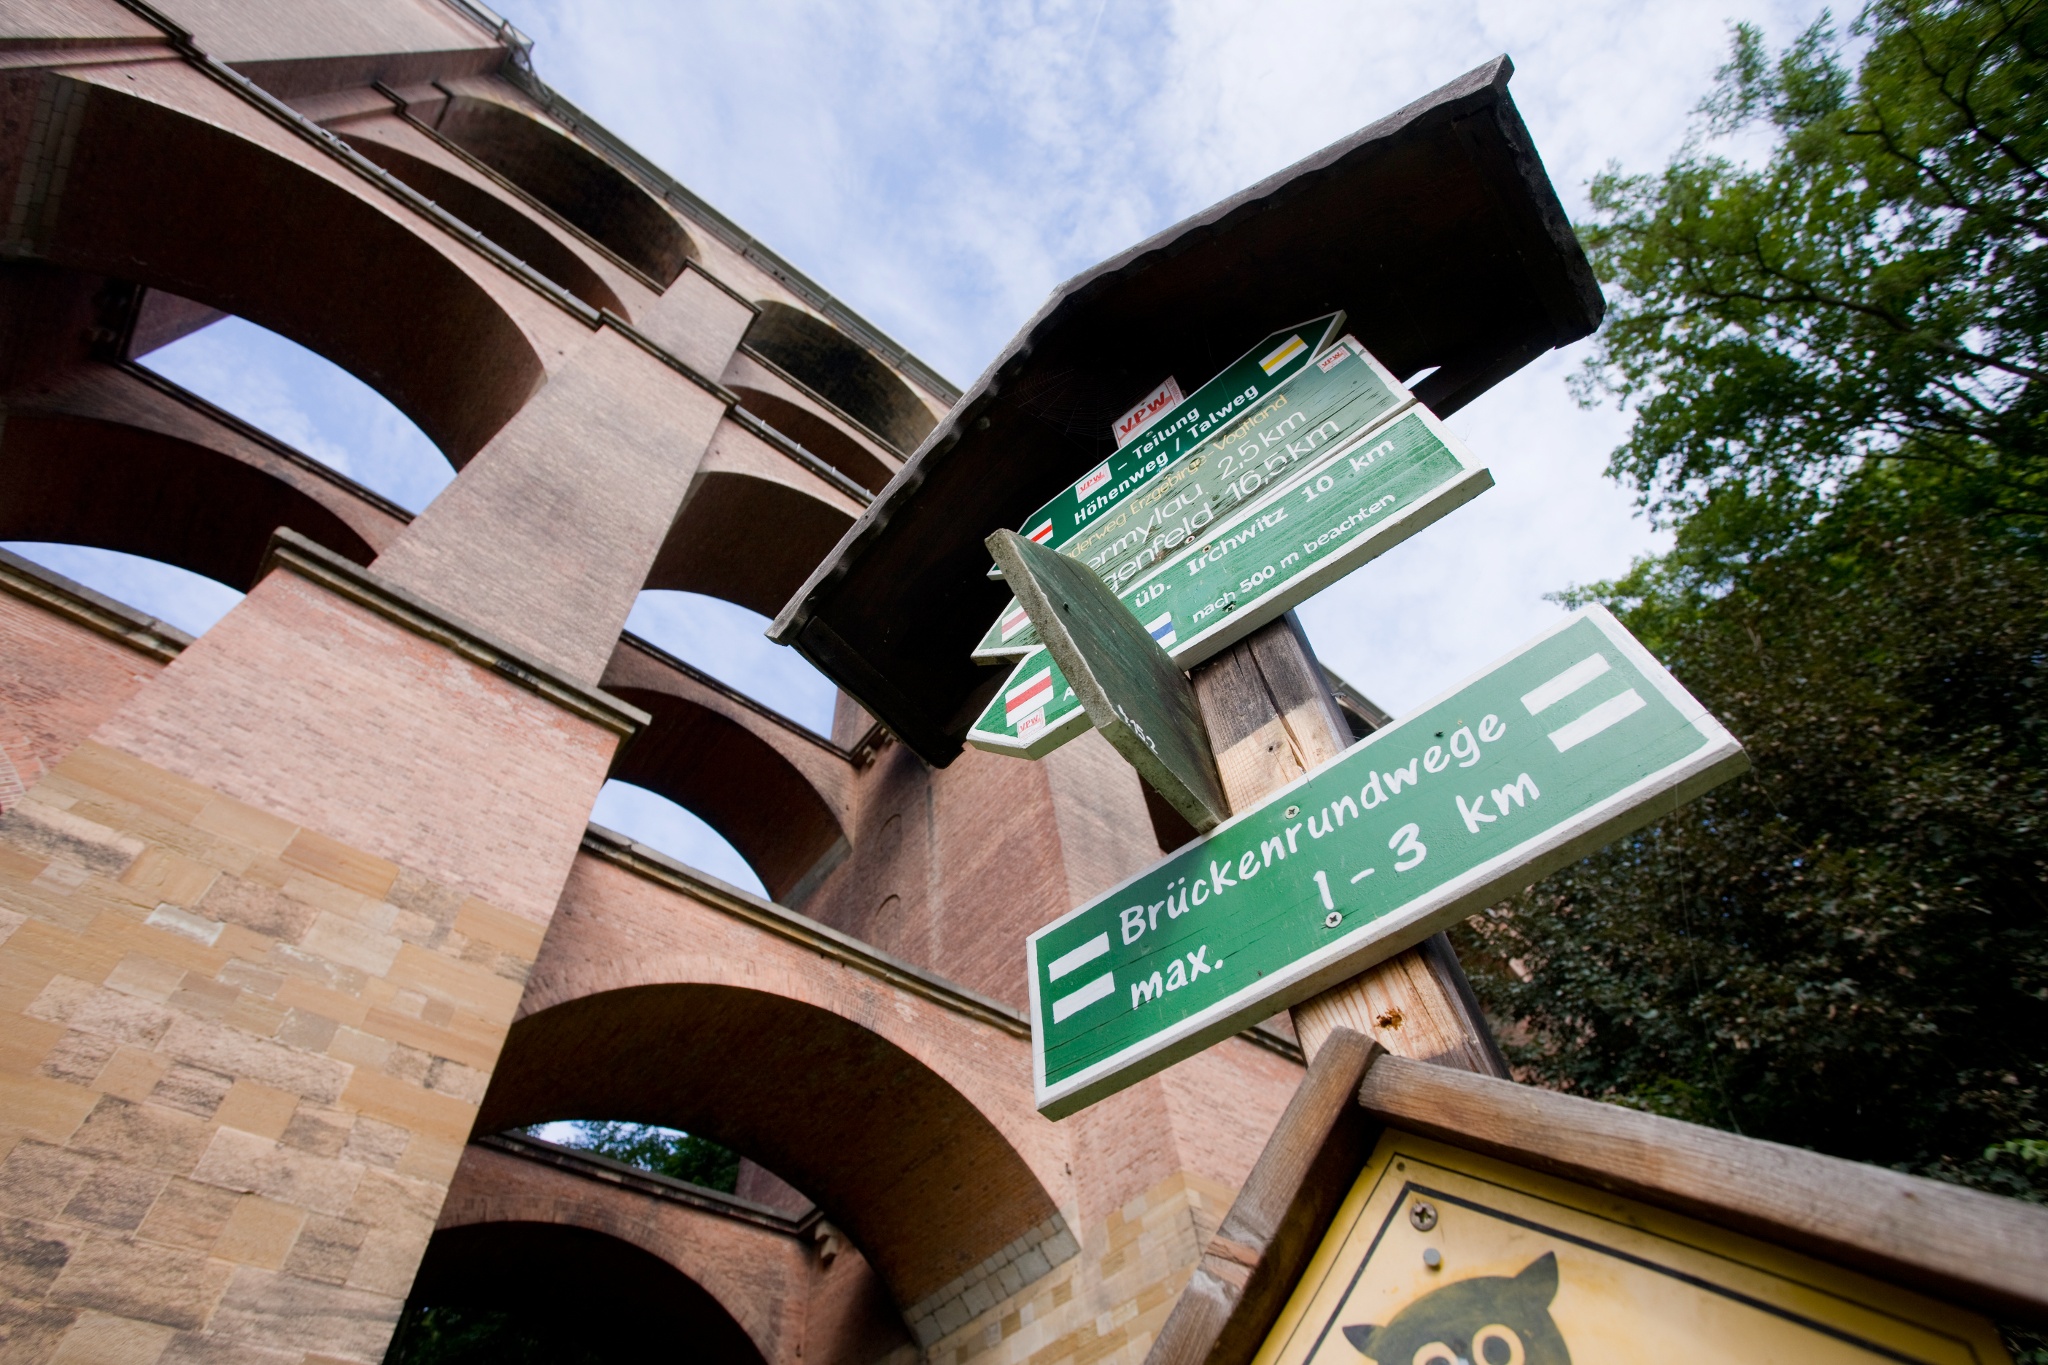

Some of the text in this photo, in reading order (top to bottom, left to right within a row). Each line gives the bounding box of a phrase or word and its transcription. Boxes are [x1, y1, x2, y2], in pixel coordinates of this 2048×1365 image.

[1074, 451, 1169, 526] Höhenweg
[1187, 385, 1259, 439] Talweg
[1120, 391, 1165, 434] VPW
[1132, 407, 1200, 460] Teilung
[1087, 483, 1204, 571] ermylau
[1103, 502, 1214, 594] genfeld
[1285, 420, 1340, 461] km
[1134, 439, 1395, 608] üb. Irchwitz 10 km
[1192, 494, 1396, 624] nach 500 m beachten
[1119, 713, 1507, 947] Brückenrundwege
[1130, 942, 1225, 1011] max.
[1312, 870, 1335, 911] 1
[1388, 822, 1427, 873] 3
[1455, 771, 1541, 835] km
